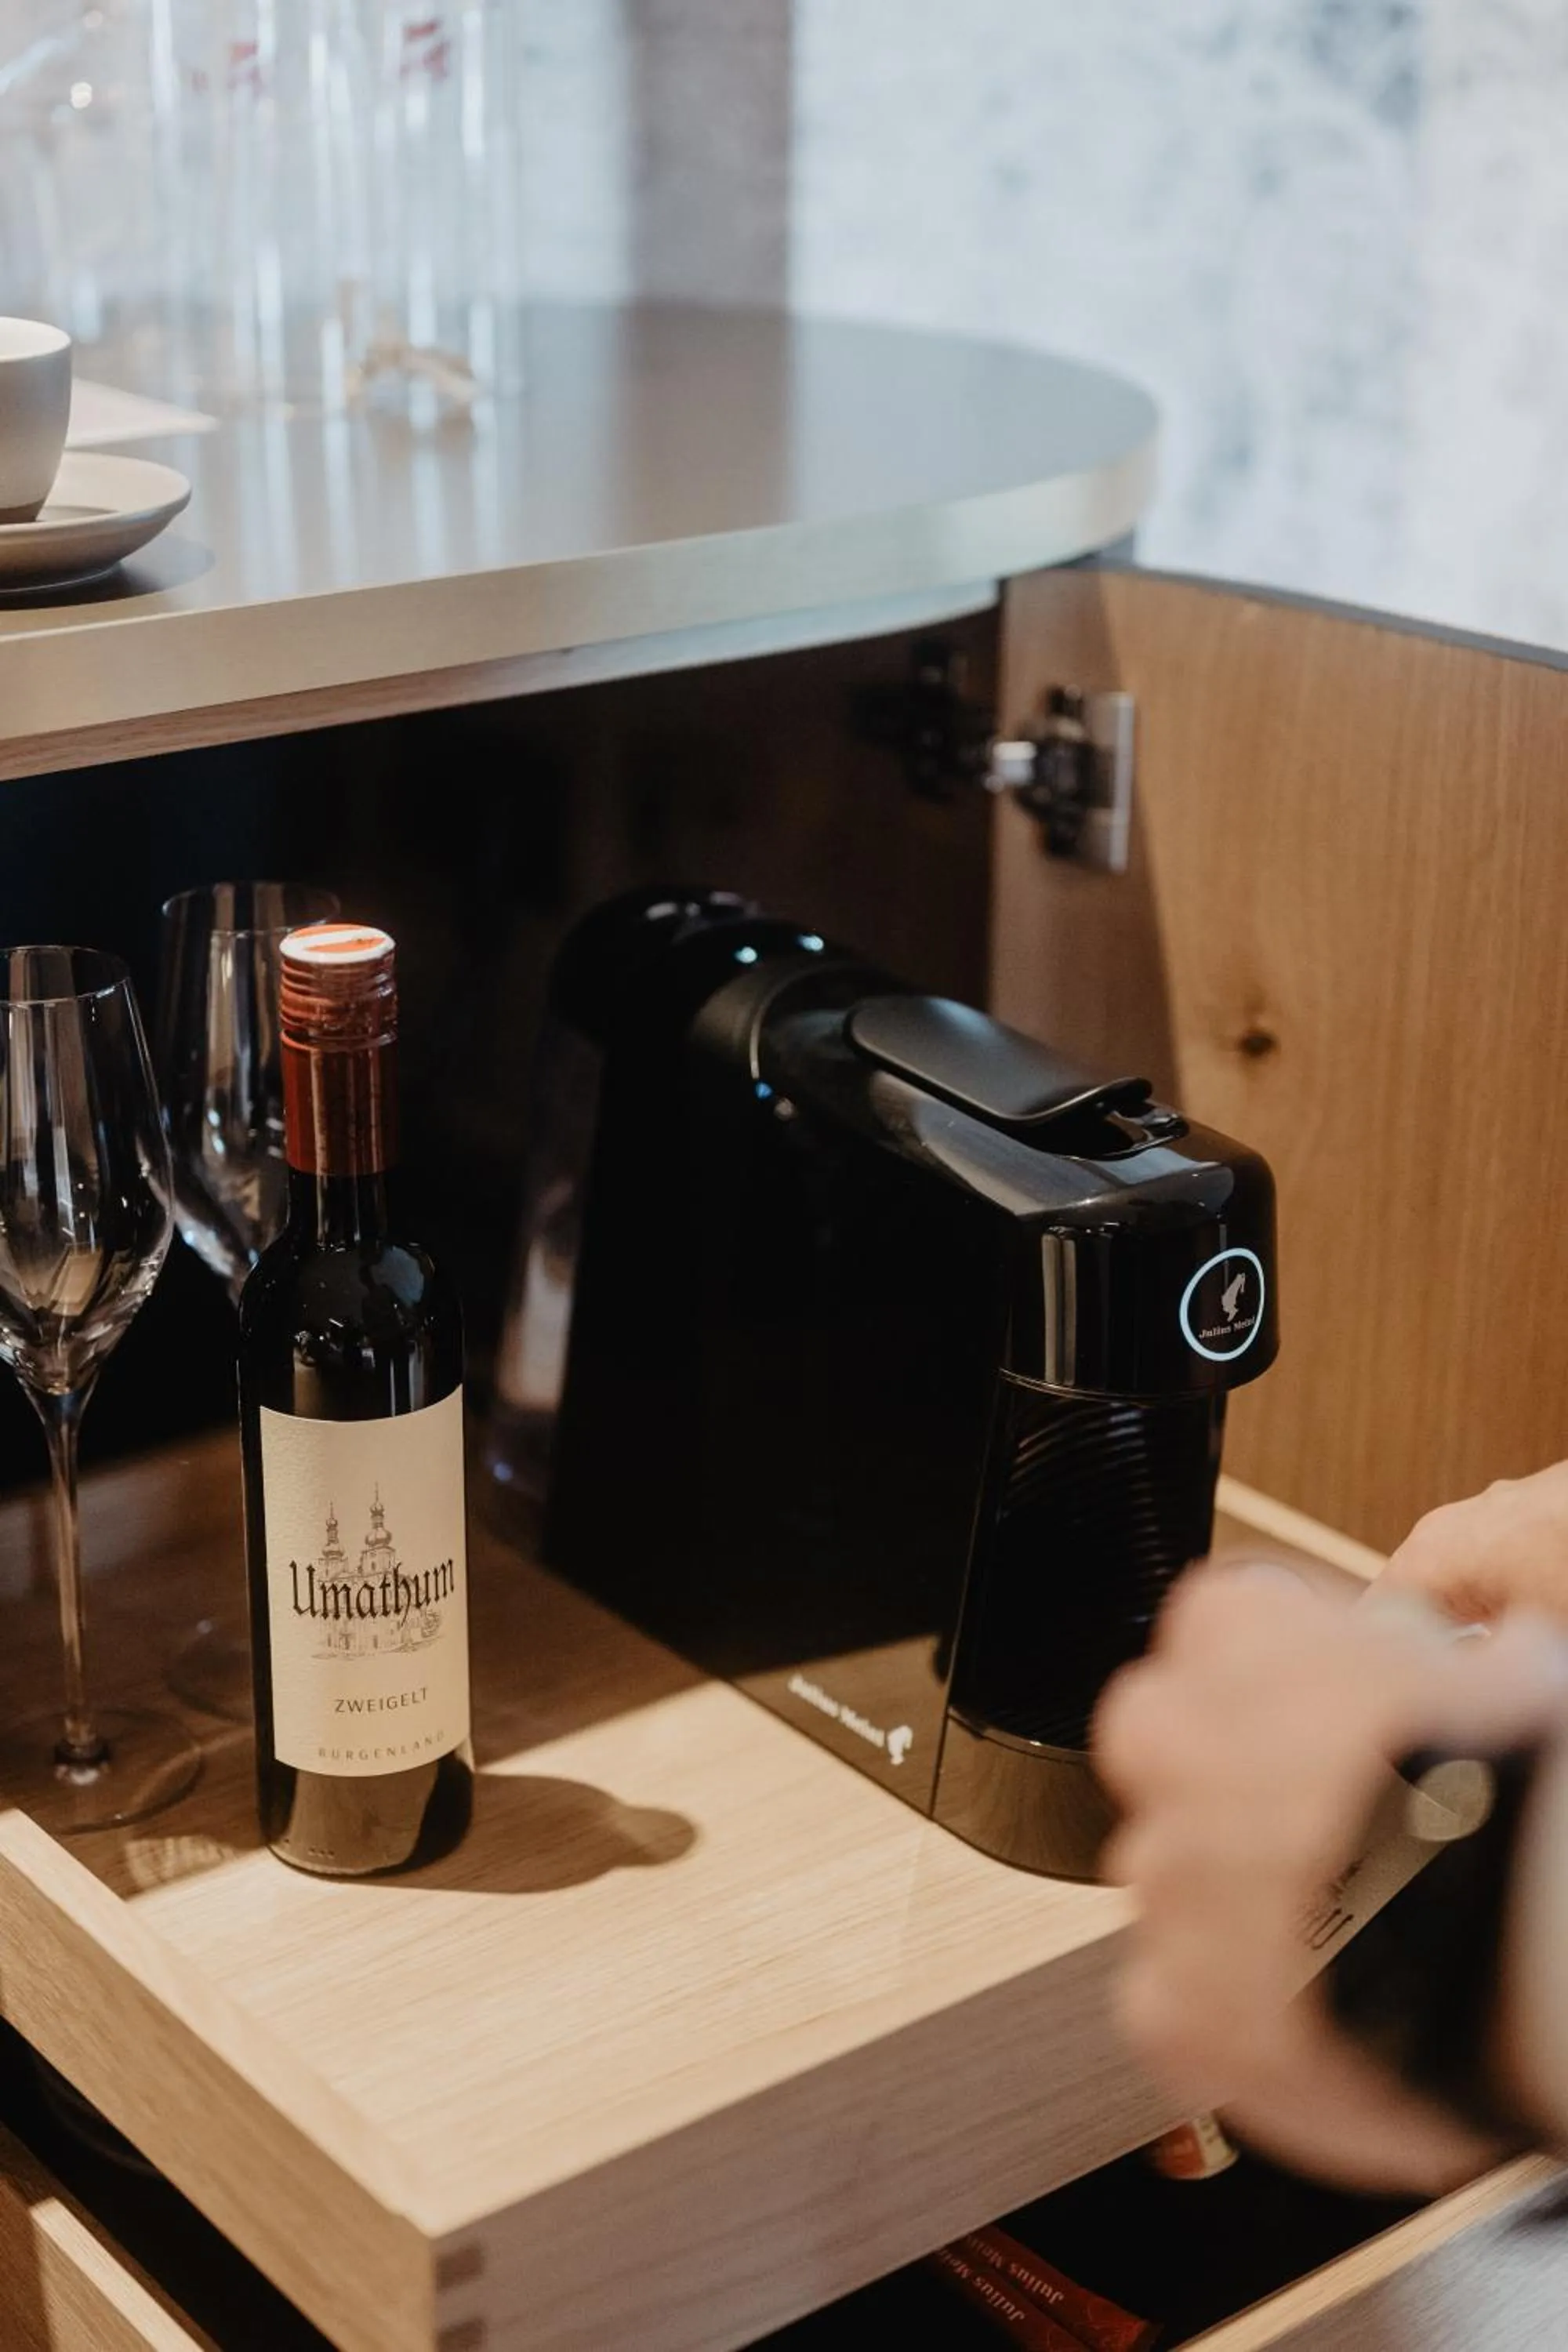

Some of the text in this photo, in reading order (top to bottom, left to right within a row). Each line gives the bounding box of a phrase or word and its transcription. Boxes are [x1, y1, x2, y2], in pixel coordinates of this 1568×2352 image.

[289, 1559, 455, 1628] Umathum
[334, 1687, 428, 1713] ZWEIGELT
[318, 1730, 445, 1761] BURGENLAND
[973, 2275, 1025, 2321] Julius
[1009, 2263, 1065, 2304] Julius
